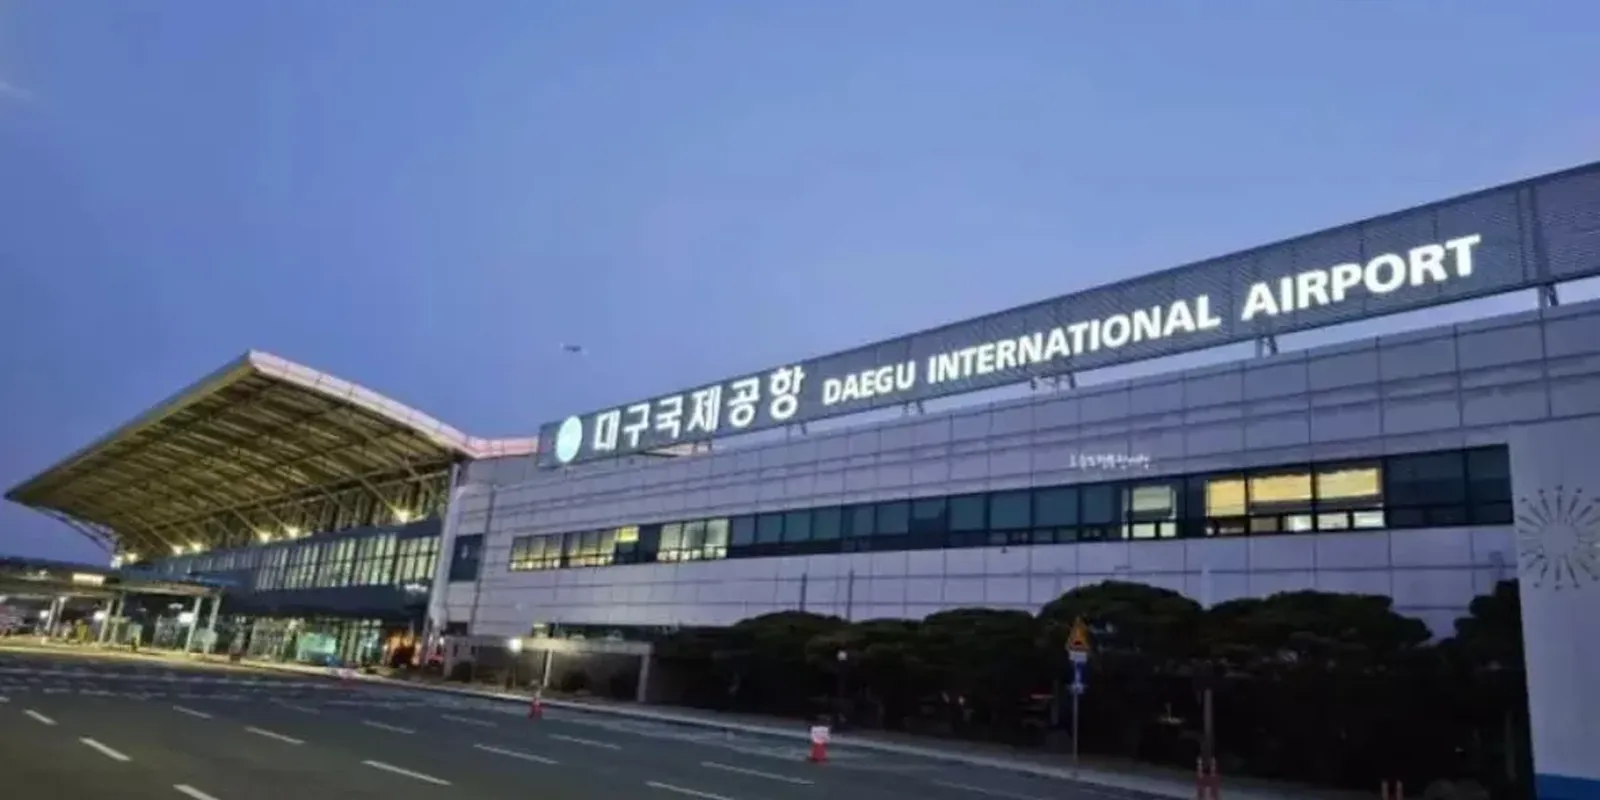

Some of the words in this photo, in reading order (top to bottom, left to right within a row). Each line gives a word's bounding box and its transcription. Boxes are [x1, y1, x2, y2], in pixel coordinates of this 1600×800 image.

[822, 360, 917, 406] DAEGU
[926, 294, 1223, 385] INTERNATIONAL
[1241, 234, 1481, 321] AIRPORT
[593, 365, 806, 452] 대구국제공항
